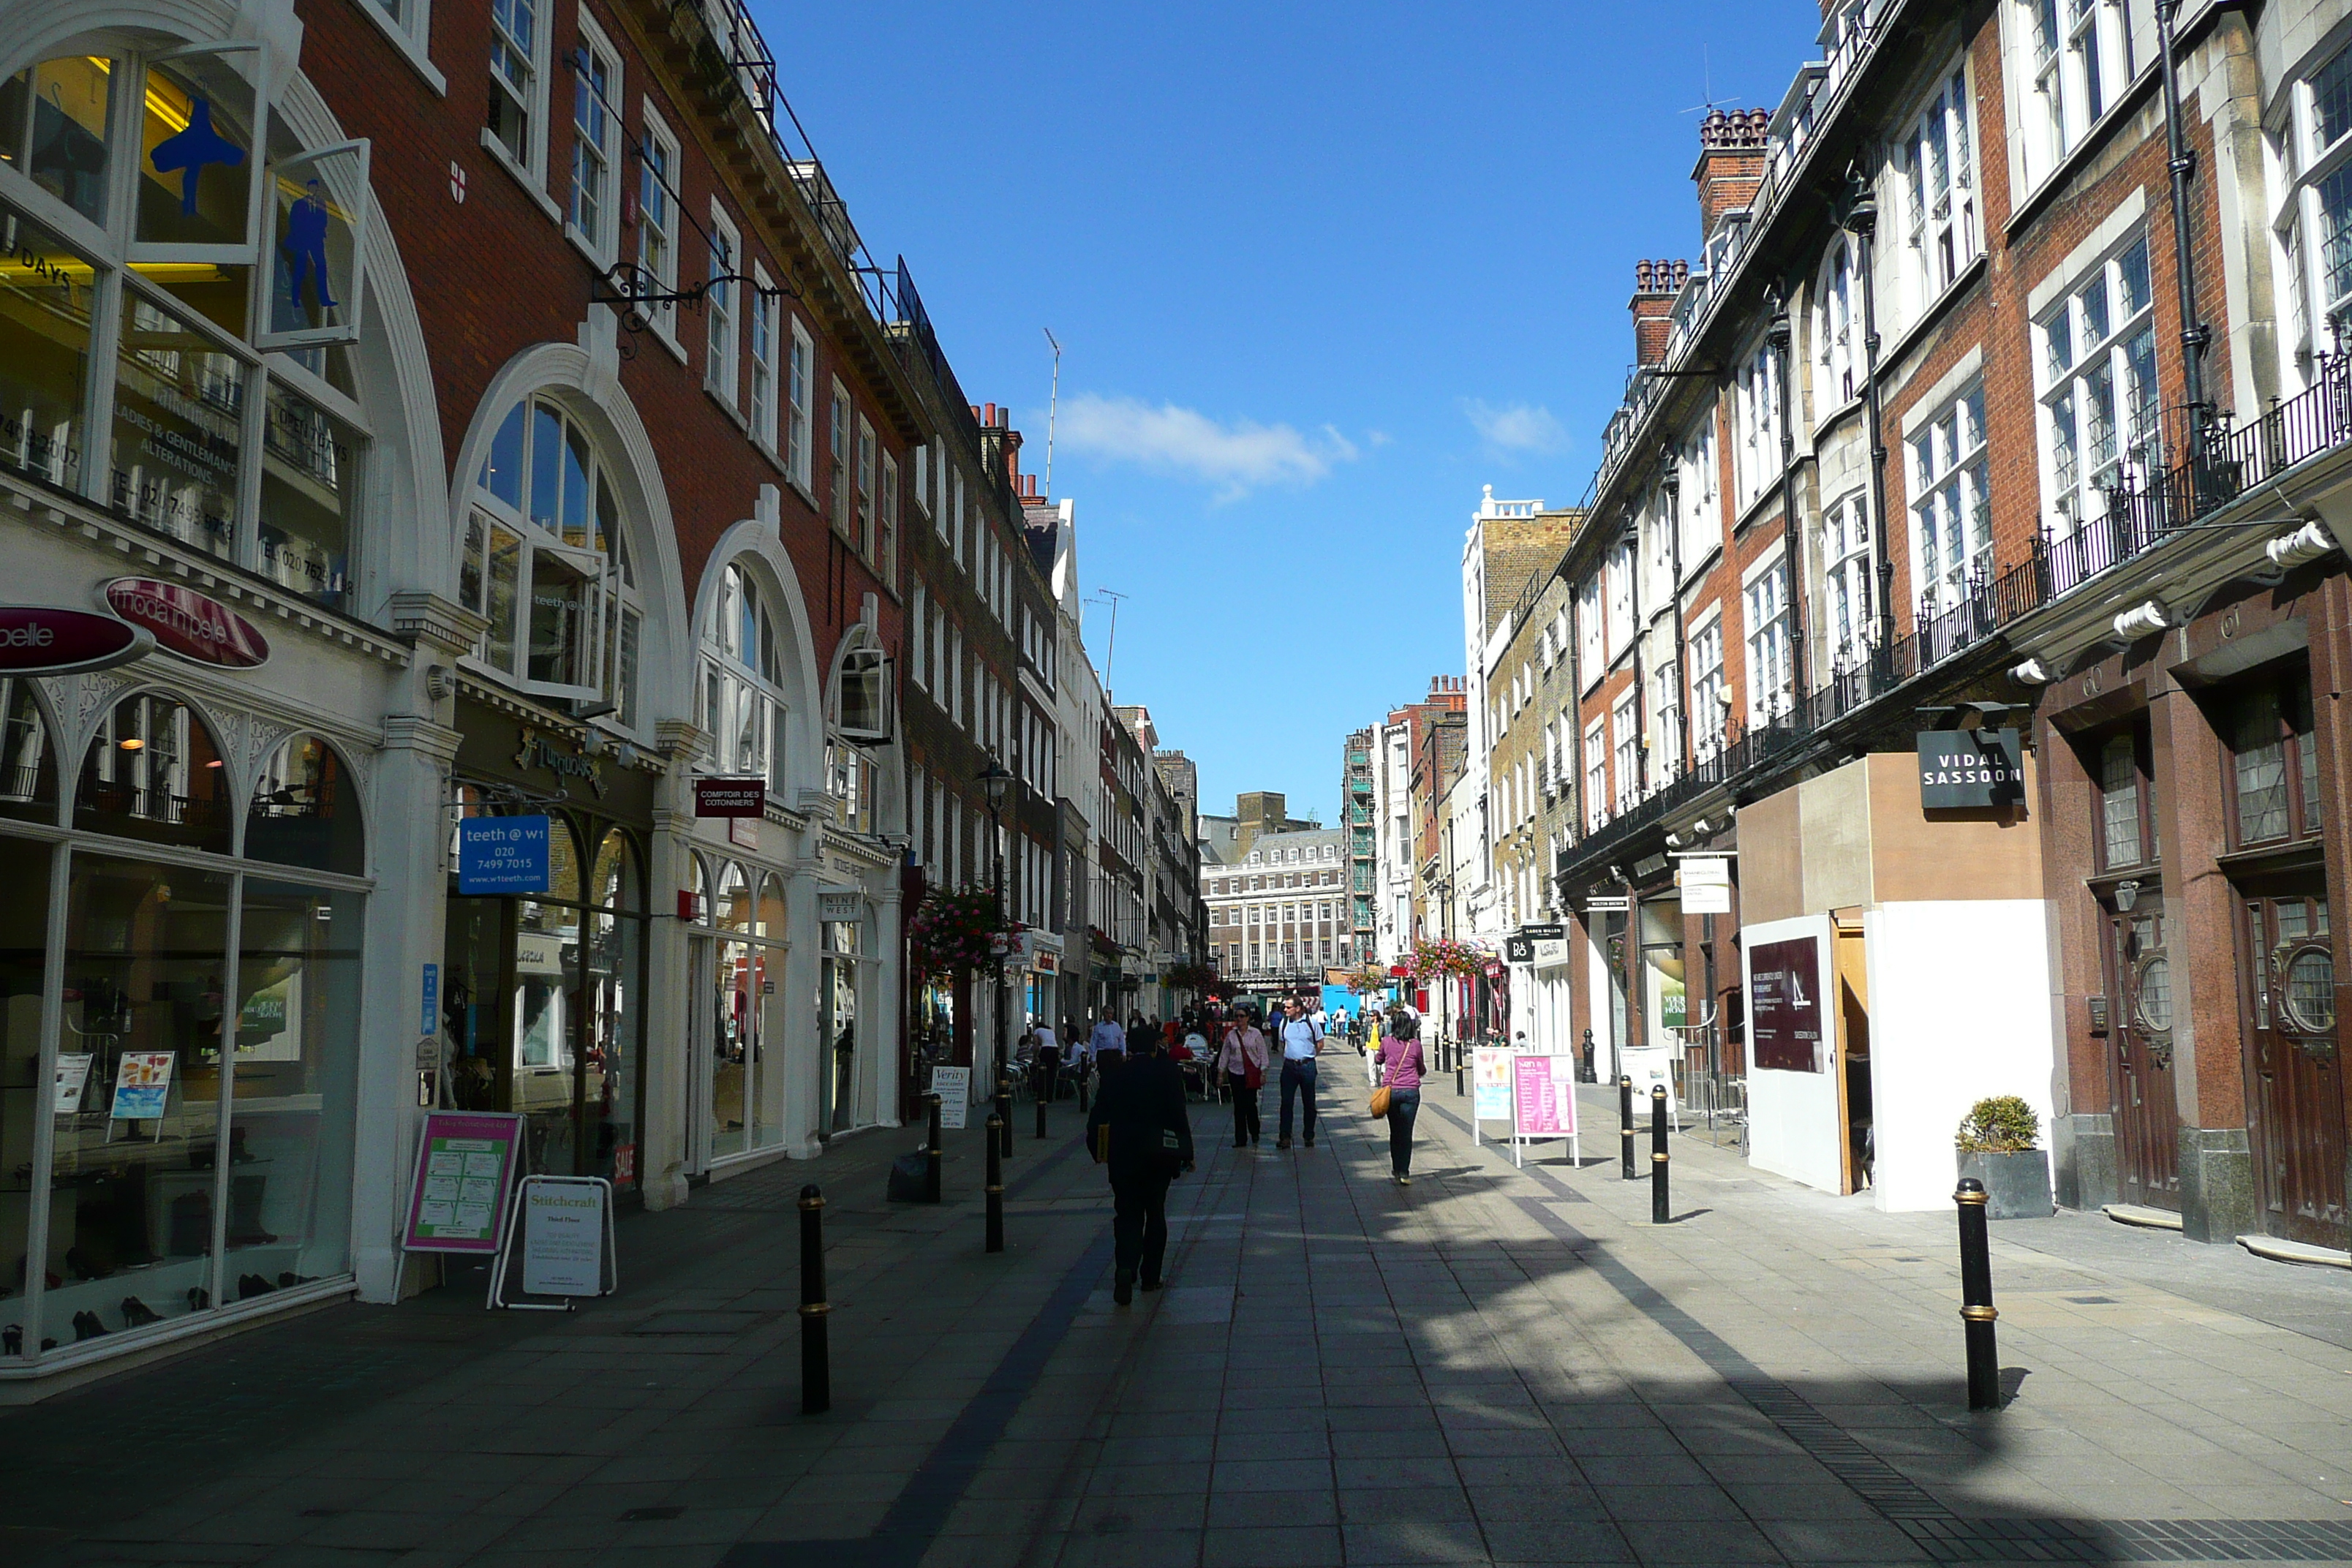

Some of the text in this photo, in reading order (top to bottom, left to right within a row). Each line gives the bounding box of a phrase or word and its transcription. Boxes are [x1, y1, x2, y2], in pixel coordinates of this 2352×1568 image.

[22, 247, 72, 292] DAYS
[114, 404, 238, 478] LADIES & GENTLEMAN'S
[535, 595, 565, 608] teeth
[568, 600, 578, 611] @
[113, 589, 227, 645] moda in pelle
[536, 737, 592, 788] Turquoise
[1938, 753, 2003, 768] VIDAL
[1923, 768, 2021, 785] SASSOON
[700, 791, 760, 799] COMPTOIR DES
[704, 799, 755, 807] COTONNIERS
[467, 828, 506, 842] teeth
[509, 828, 521, 842] @
[494, 847, 515, 857] 020
[477, 858, 532, 870] 7499 7015
[468, 873, 541, 884] www.w1teeth.com
[937, 1068, 964, 1082] Verity
[614, 1149, 634, 1179] SALE
[531, 1194, 596, 1207] Stitchcraft
